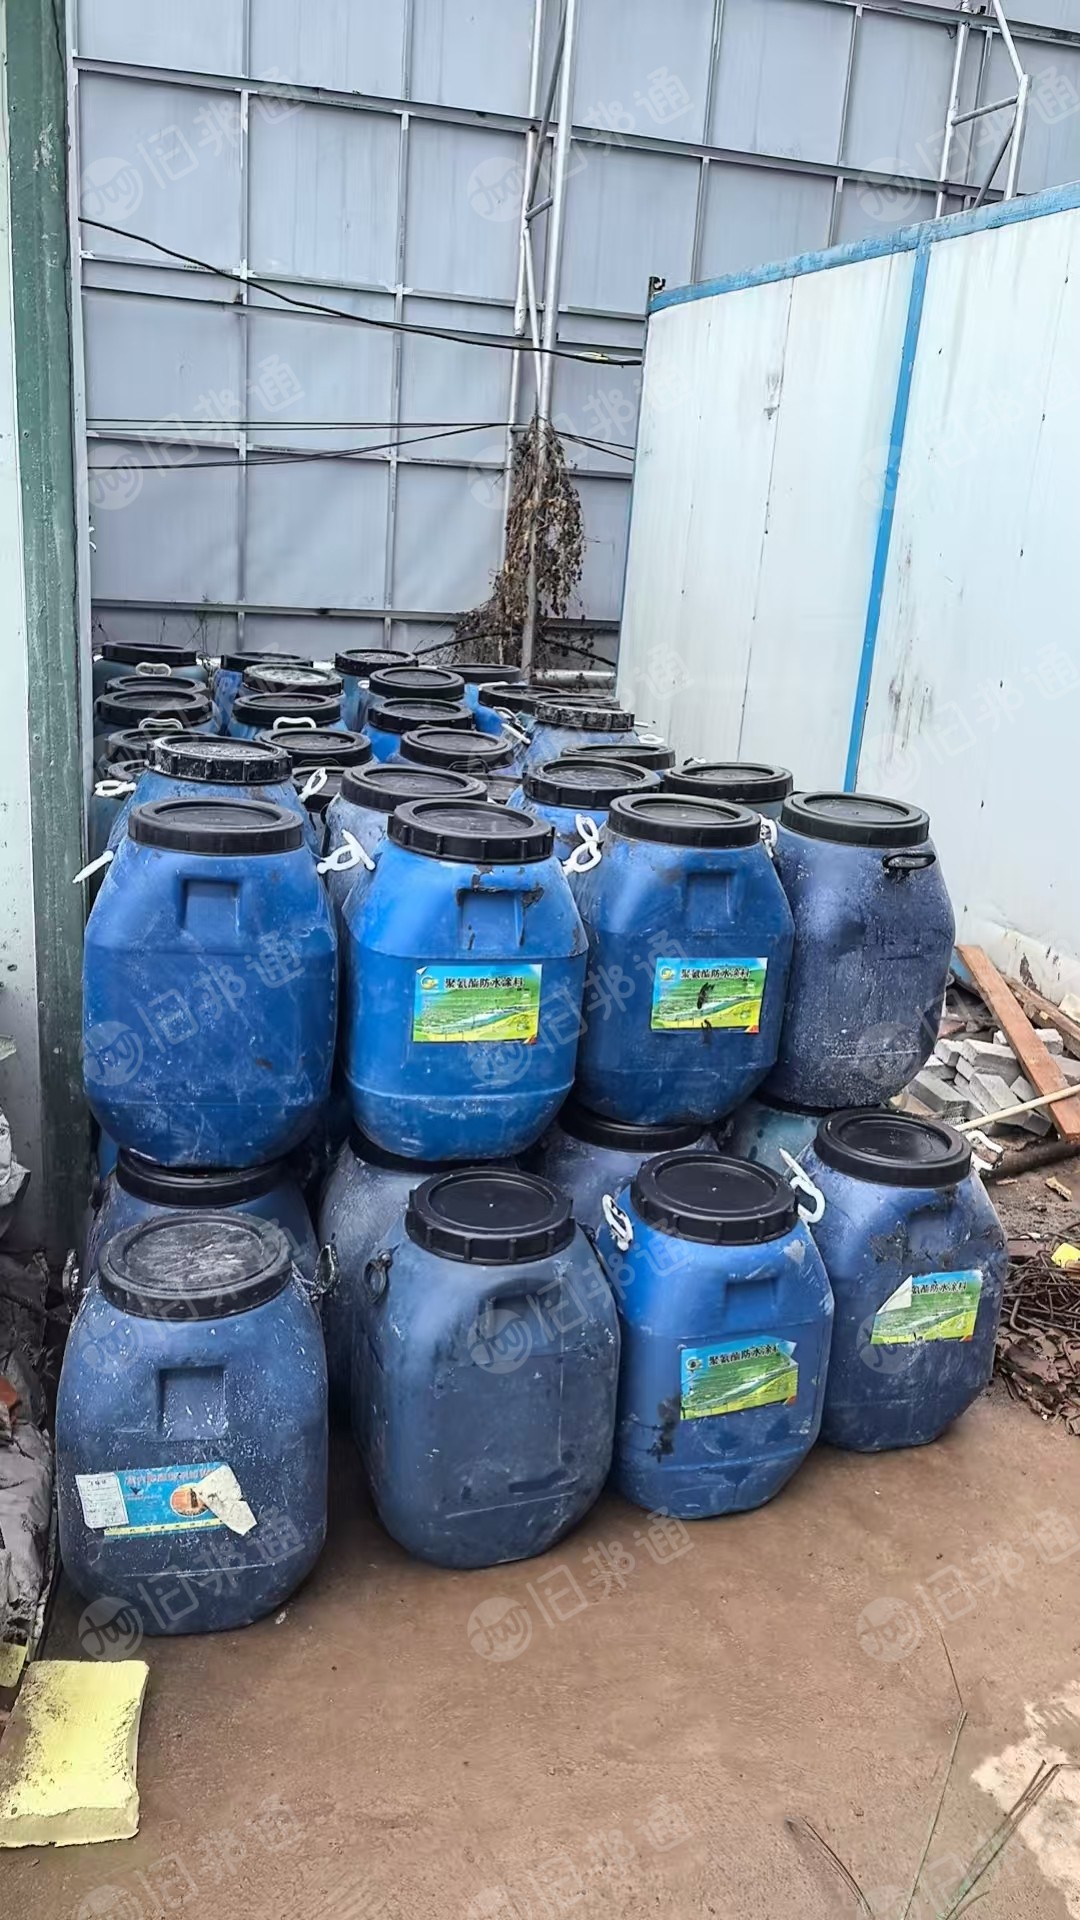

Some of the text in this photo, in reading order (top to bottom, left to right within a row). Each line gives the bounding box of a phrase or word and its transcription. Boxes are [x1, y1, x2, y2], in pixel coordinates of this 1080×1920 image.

[445, 977, 524, 989] 聚氨酯防水涂料
